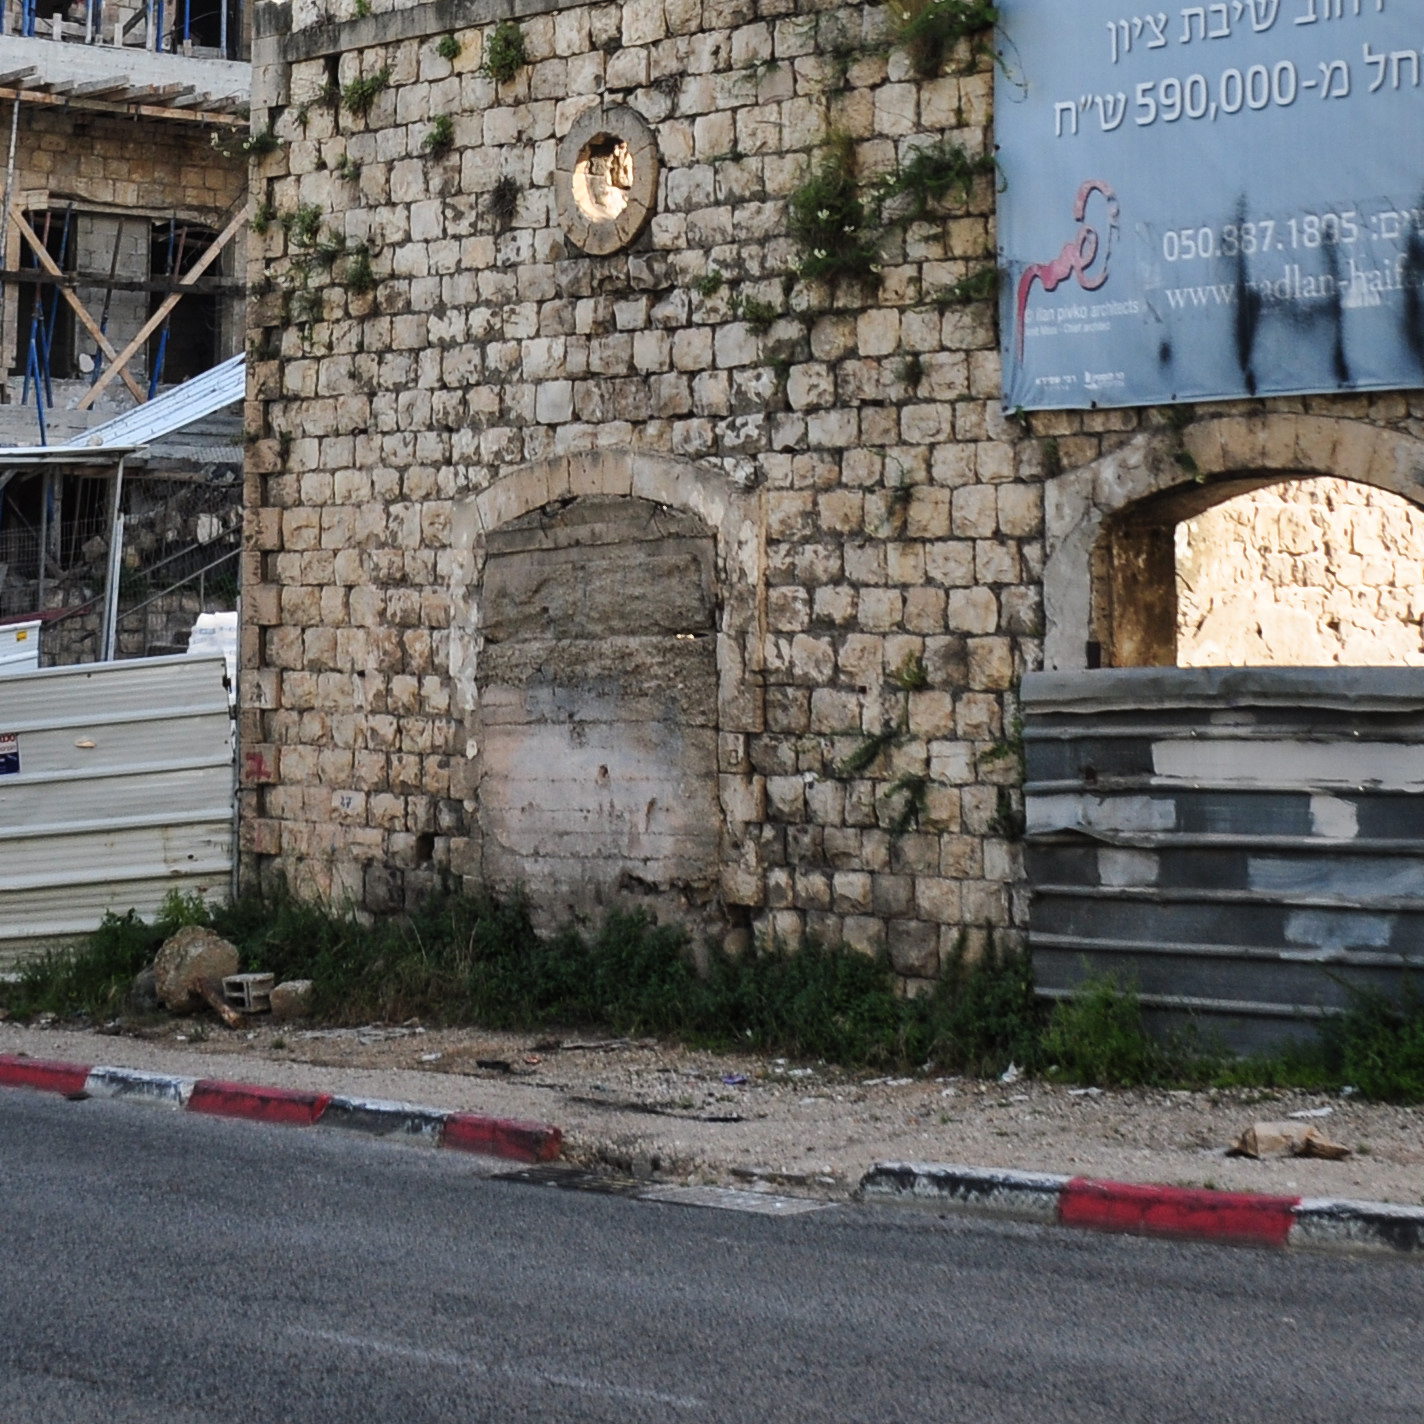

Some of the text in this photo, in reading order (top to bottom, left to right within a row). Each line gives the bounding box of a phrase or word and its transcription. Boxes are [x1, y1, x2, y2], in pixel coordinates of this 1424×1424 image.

[1106, 11, 1168, 65] ציון
[1053, 91, 1128, 138] ש"ח
[1134, 58, 1351, 128] מ-590,000
